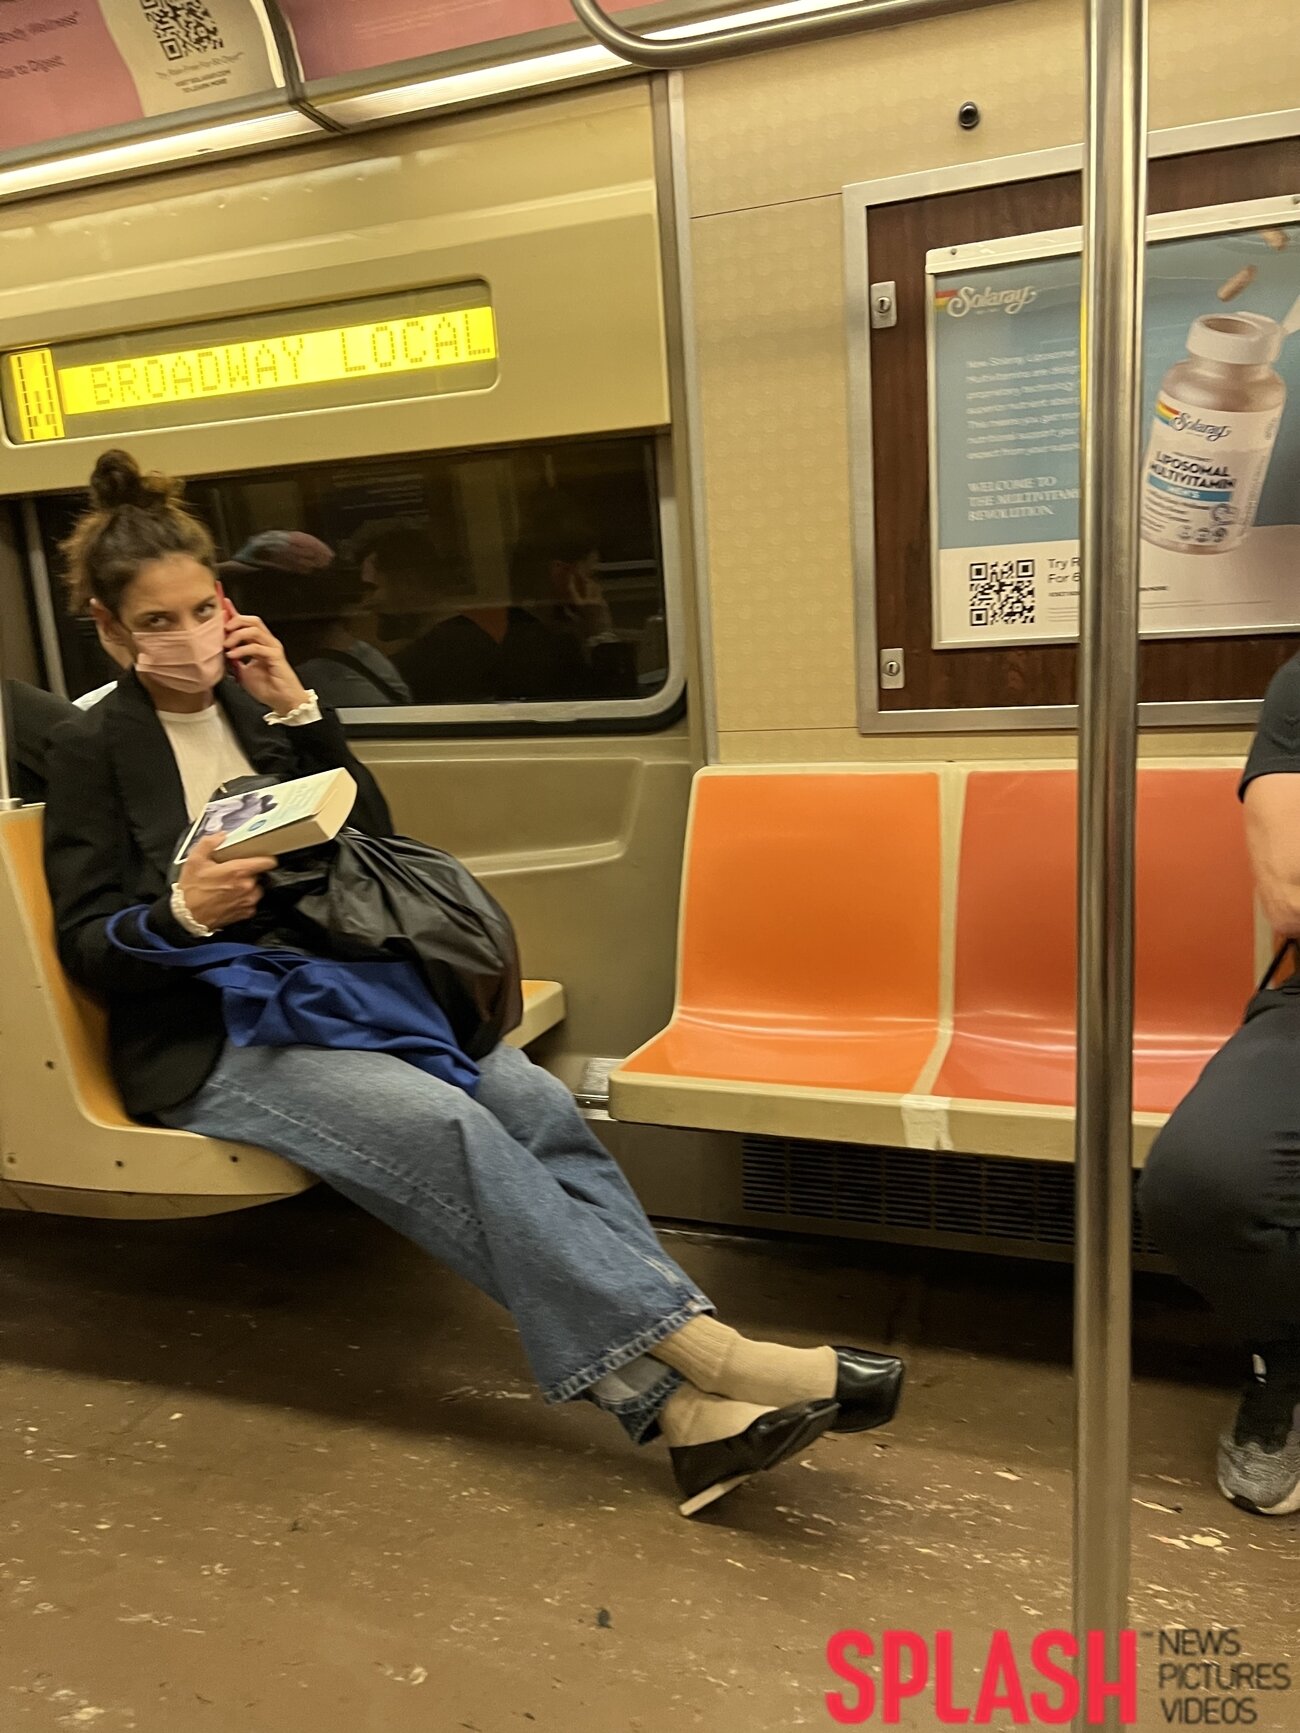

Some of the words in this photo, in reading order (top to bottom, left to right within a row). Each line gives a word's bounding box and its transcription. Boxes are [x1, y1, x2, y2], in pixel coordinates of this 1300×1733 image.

[946, 286, 1037, 317] Solaray
[89, 336, 305, 406] BROADWAY
[339, 312, 492, 374] LOCAL
[16, 352, 59, 440] W
[1170, 412, 1232, 442] Solaray
[1150, 462, 1237, 489] MULTIVITAMIN
[1156, 451, 1230, 477] LIPOSOMAL
[967, 478, 1036, 493] WELCOME
[1036, 476, 1057, 488] TO
[996, 488, 1080, 505] MULTIVITAM
[1046, 558, 1069, 571] Try
[1047, 573, 1070, 584] For
